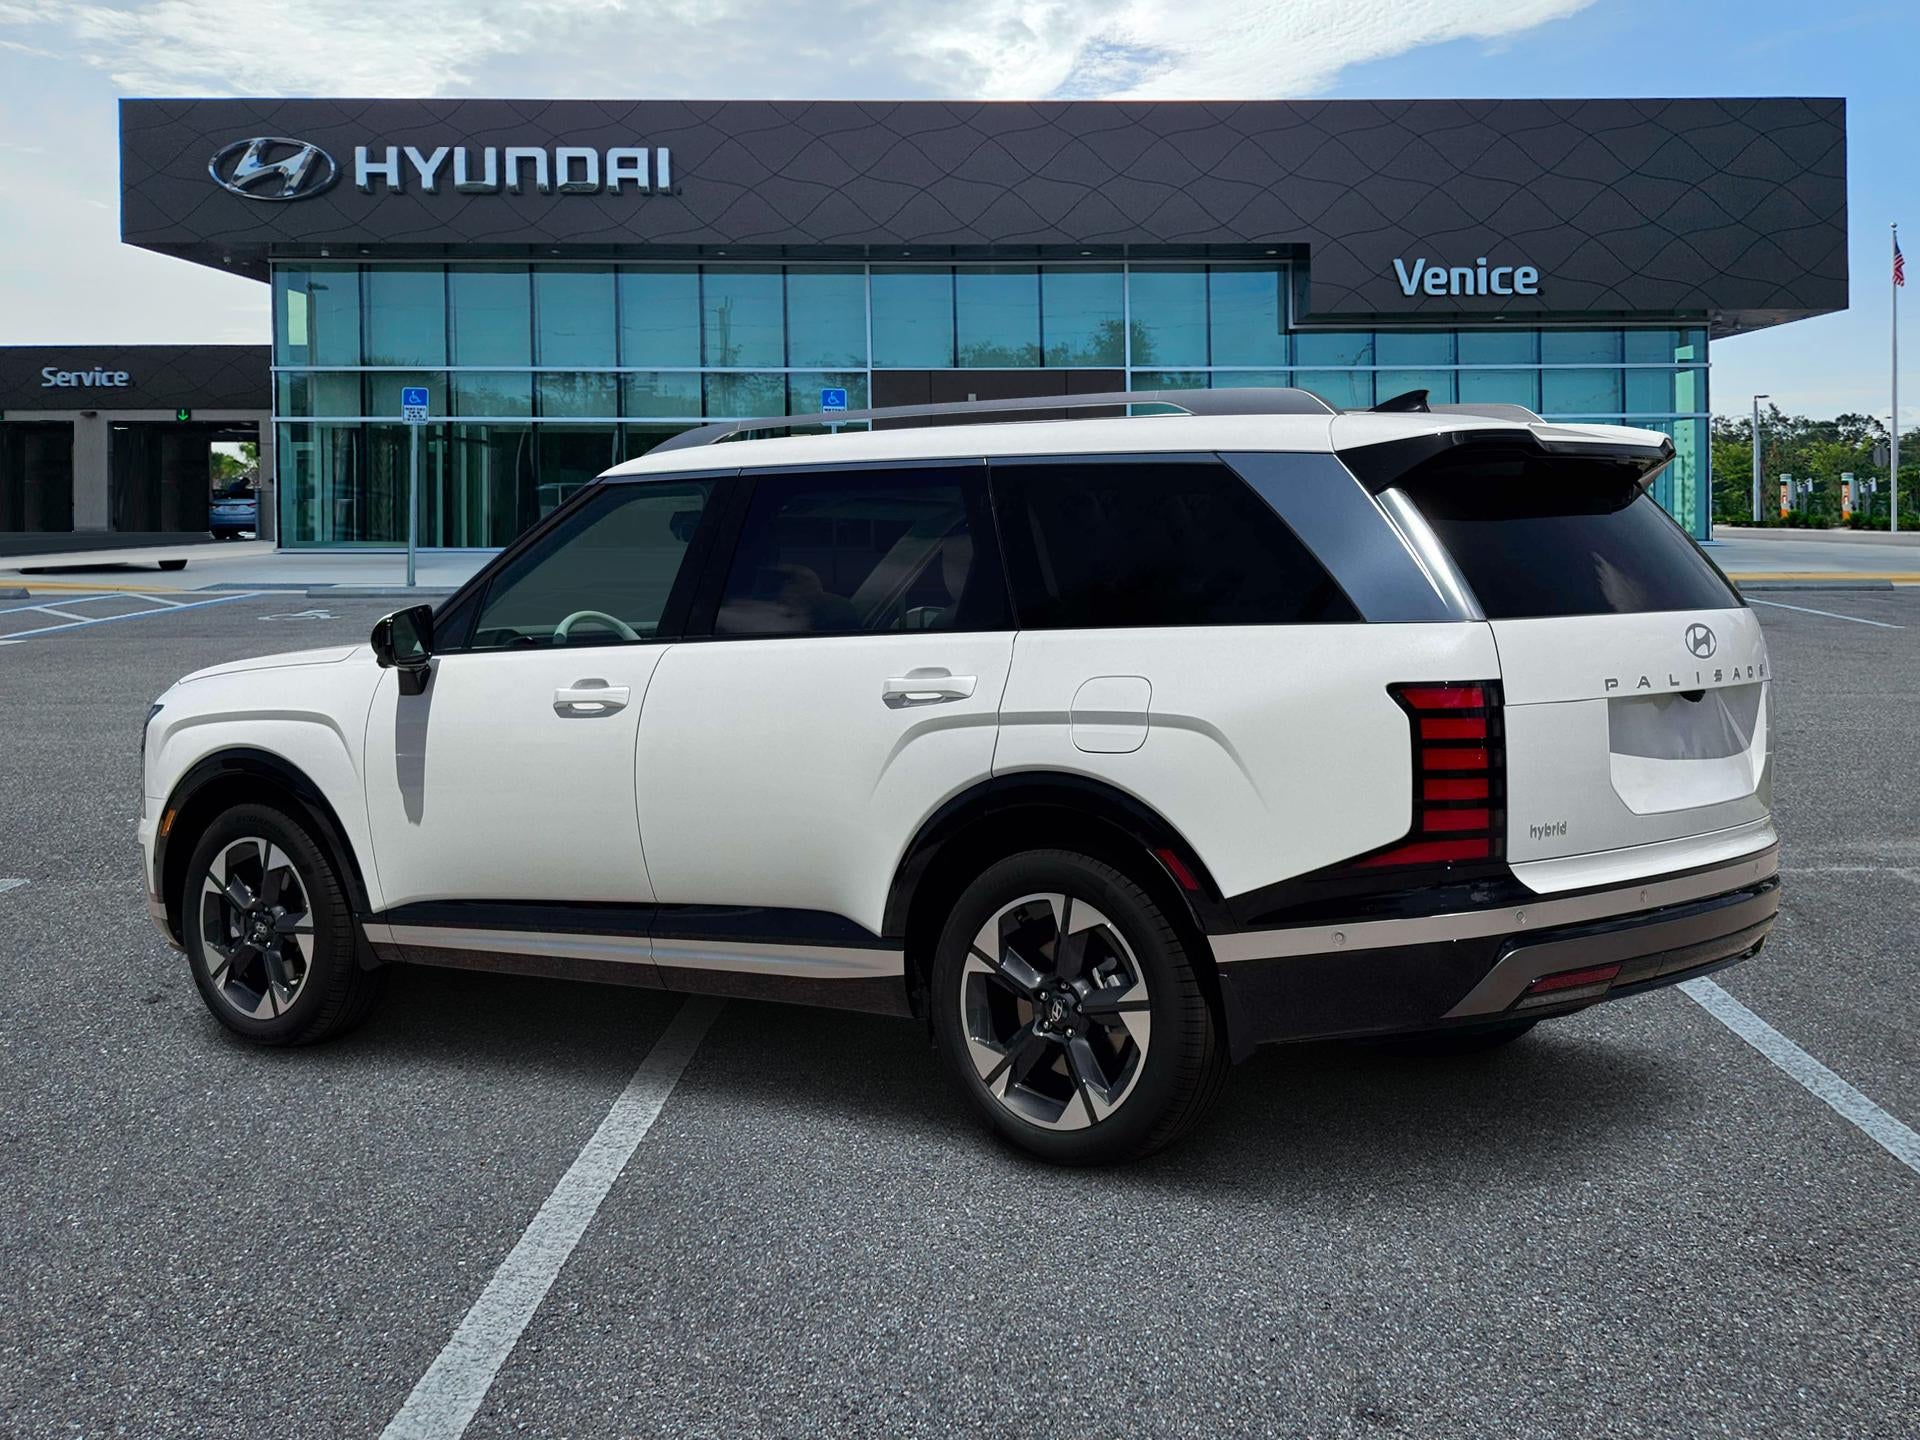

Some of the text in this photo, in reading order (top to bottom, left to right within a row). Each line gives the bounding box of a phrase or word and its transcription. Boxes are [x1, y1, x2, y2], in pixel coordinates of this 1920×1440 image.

[354, 146, 673, 194] HYUNDAI
[1392, 256, 1540, 297] Venice
[41, 366, 130, 388] Service
[1604, 663, 1764, 692] PALISADE
[1529, 820, 1568, 841] hybrid
